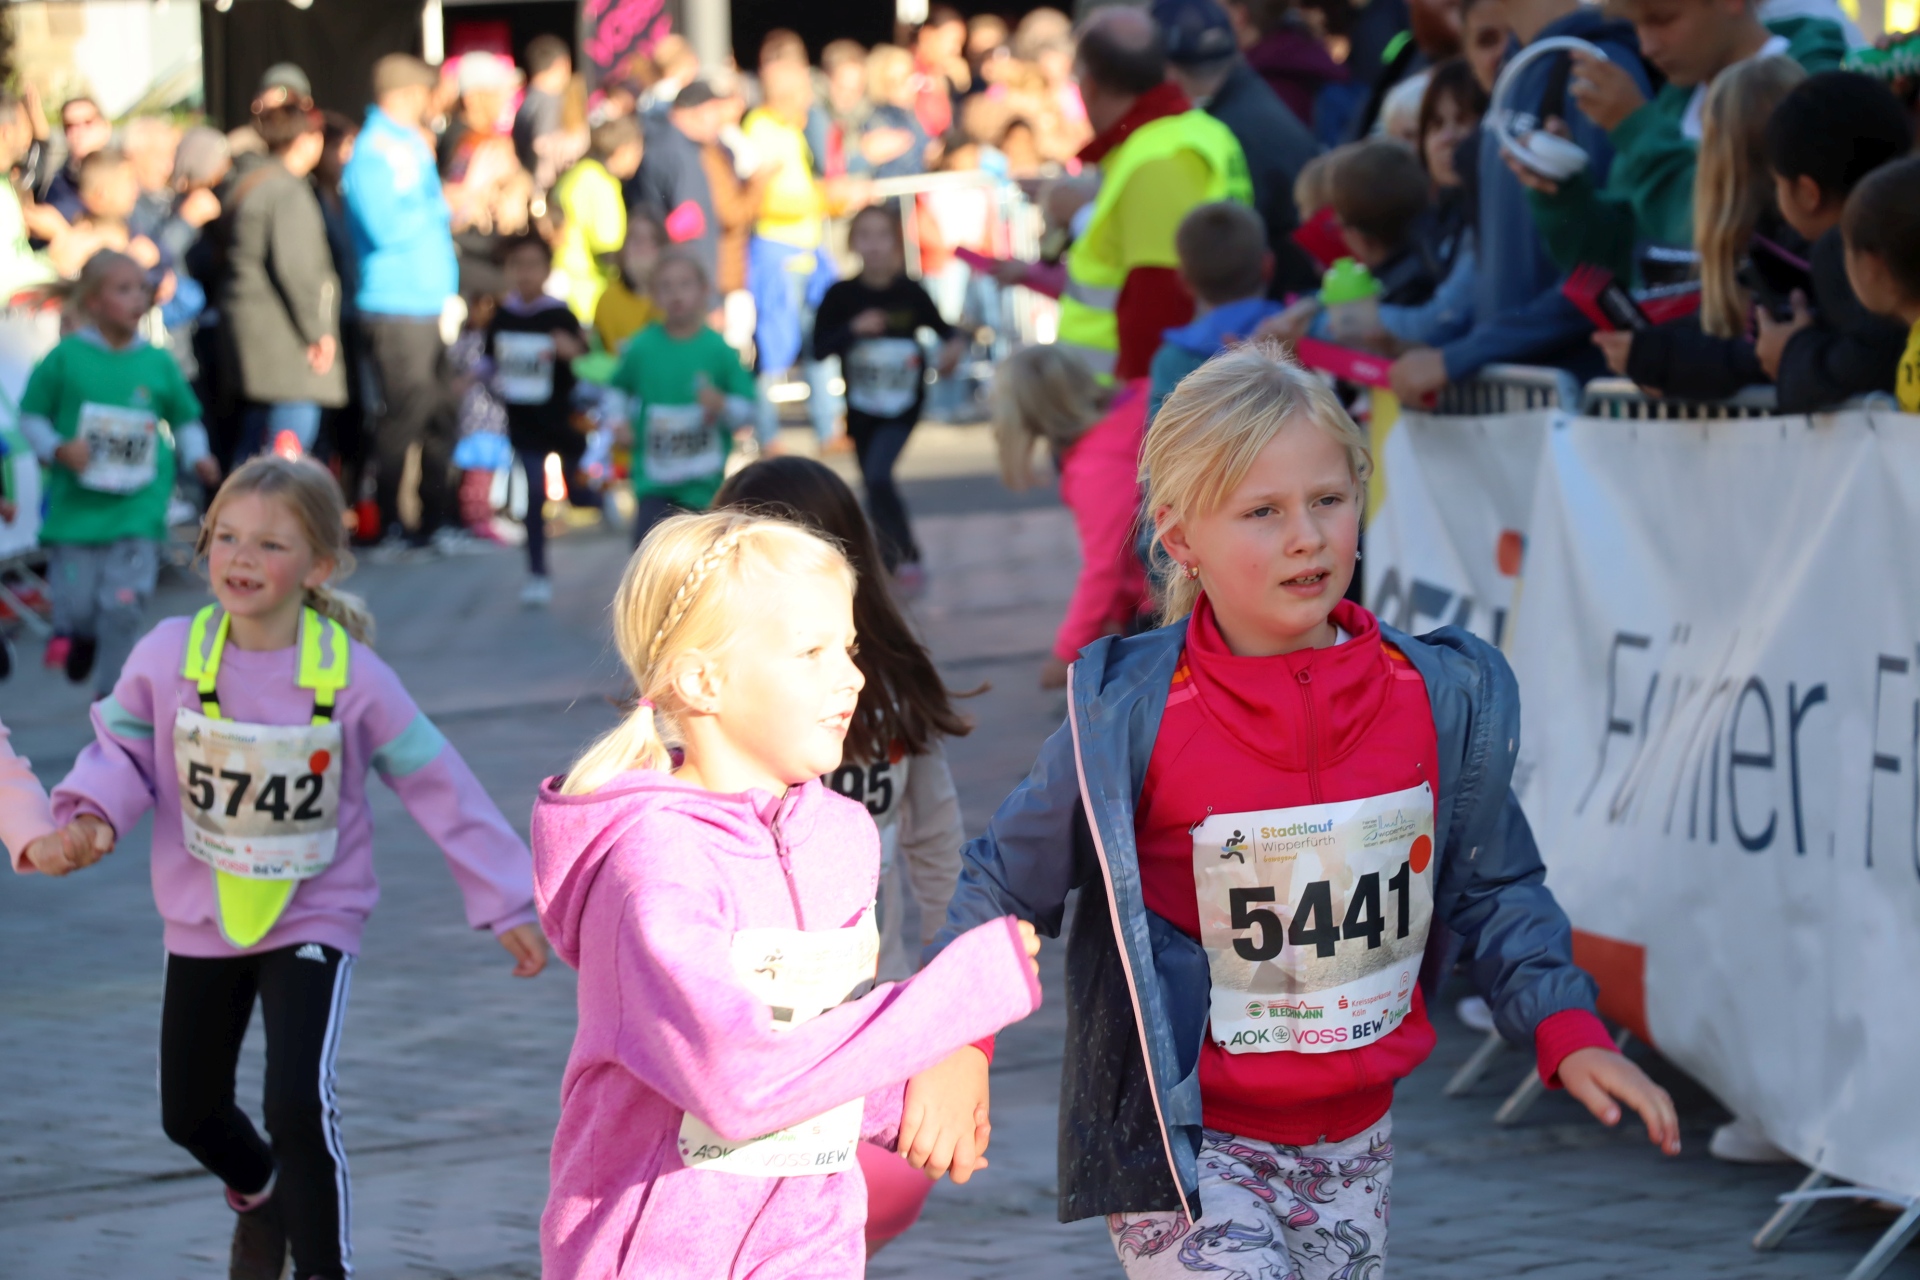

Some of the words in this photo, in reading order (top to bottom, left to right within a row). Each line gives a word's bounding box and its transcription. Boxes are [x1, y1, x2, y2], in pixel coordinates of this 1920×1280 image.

[188, 760, 323, 821] 5742
[1261, 819, 1333, 839] Stadtlauf
[1261, 835, 1336, 852] Wipperfürth
[1229, 860, 1409, 961] 5441
[1352, 991, 1391, 1007] Kreissparkasse
[1269, 1007, 1323, 1019] BLECHMANN
[1352, 1009, 1366, 1018] Köln
[1230, 1028, 1271, 1046] AOK
[1292, 1027, 1348, 1045] VOSS
[1352, 1017, 1385, 1040] BEW
[762, 1153, 811, 1167] VOSS
[815, 1147, 849, 1166] BEW
